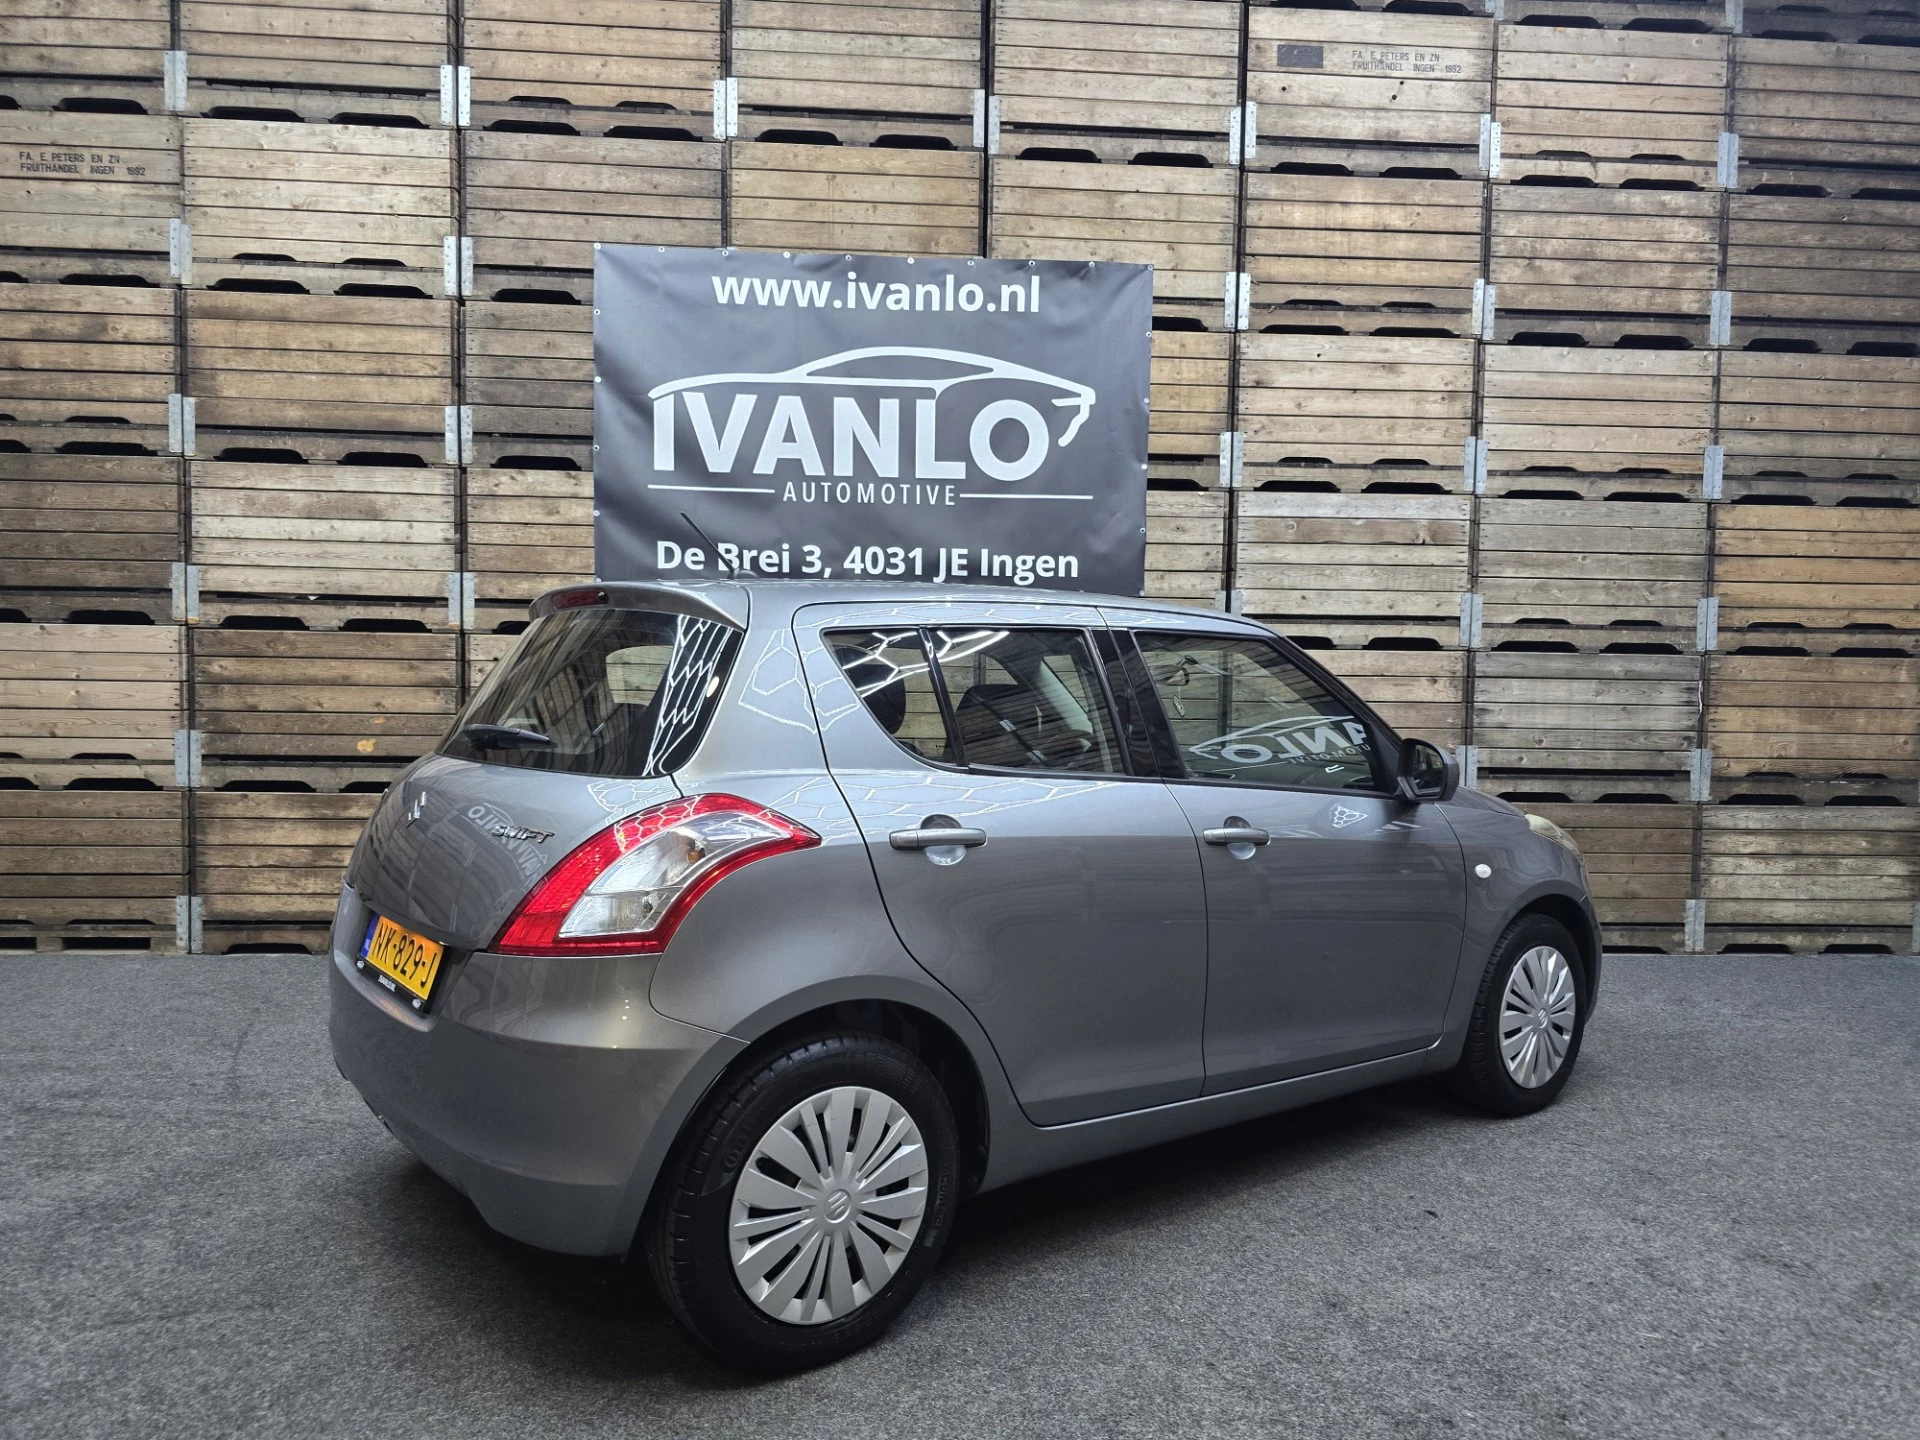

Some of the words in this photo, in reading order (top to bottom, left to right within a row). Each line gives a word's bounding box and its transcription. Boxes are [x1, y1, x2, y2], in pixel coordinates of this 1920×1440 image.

[1352, 60, 1405, 72] FRUITHANDEL
[1412, 63, 1435, 73] INGEN
[1380, 52, 1410, 61] PETERS
[1415, 53, 1426, 62] EN
[1429, 53, 1440, 62] ZN
[20, 162, 80, 174] FRUITHANDEL
[90, 165, 115, 175] INGEN
[51, 152, 86, 163] PETERS
[91, 154, 103, 164] EN
[108, 154, 120, 164] ZN
[711, 271, 1040, 313] www.ivanlo.nl
[652, 390, 1050, 482] IVANLO
[782, 480, 956, 506] AUTOMOTIVE
[656, 540, 706, 571] De
[717, 542, 791, 574] Brei
[800, 544, 832, 579] 3,
[843, 545, 924, 576] 4031
[932, 547, 969, 584] JE
[980, 548, 1079, 587] Ingen
[490, 824, 556, 844] SWIFT
[371, 922, 438, 989] NK-829-J
